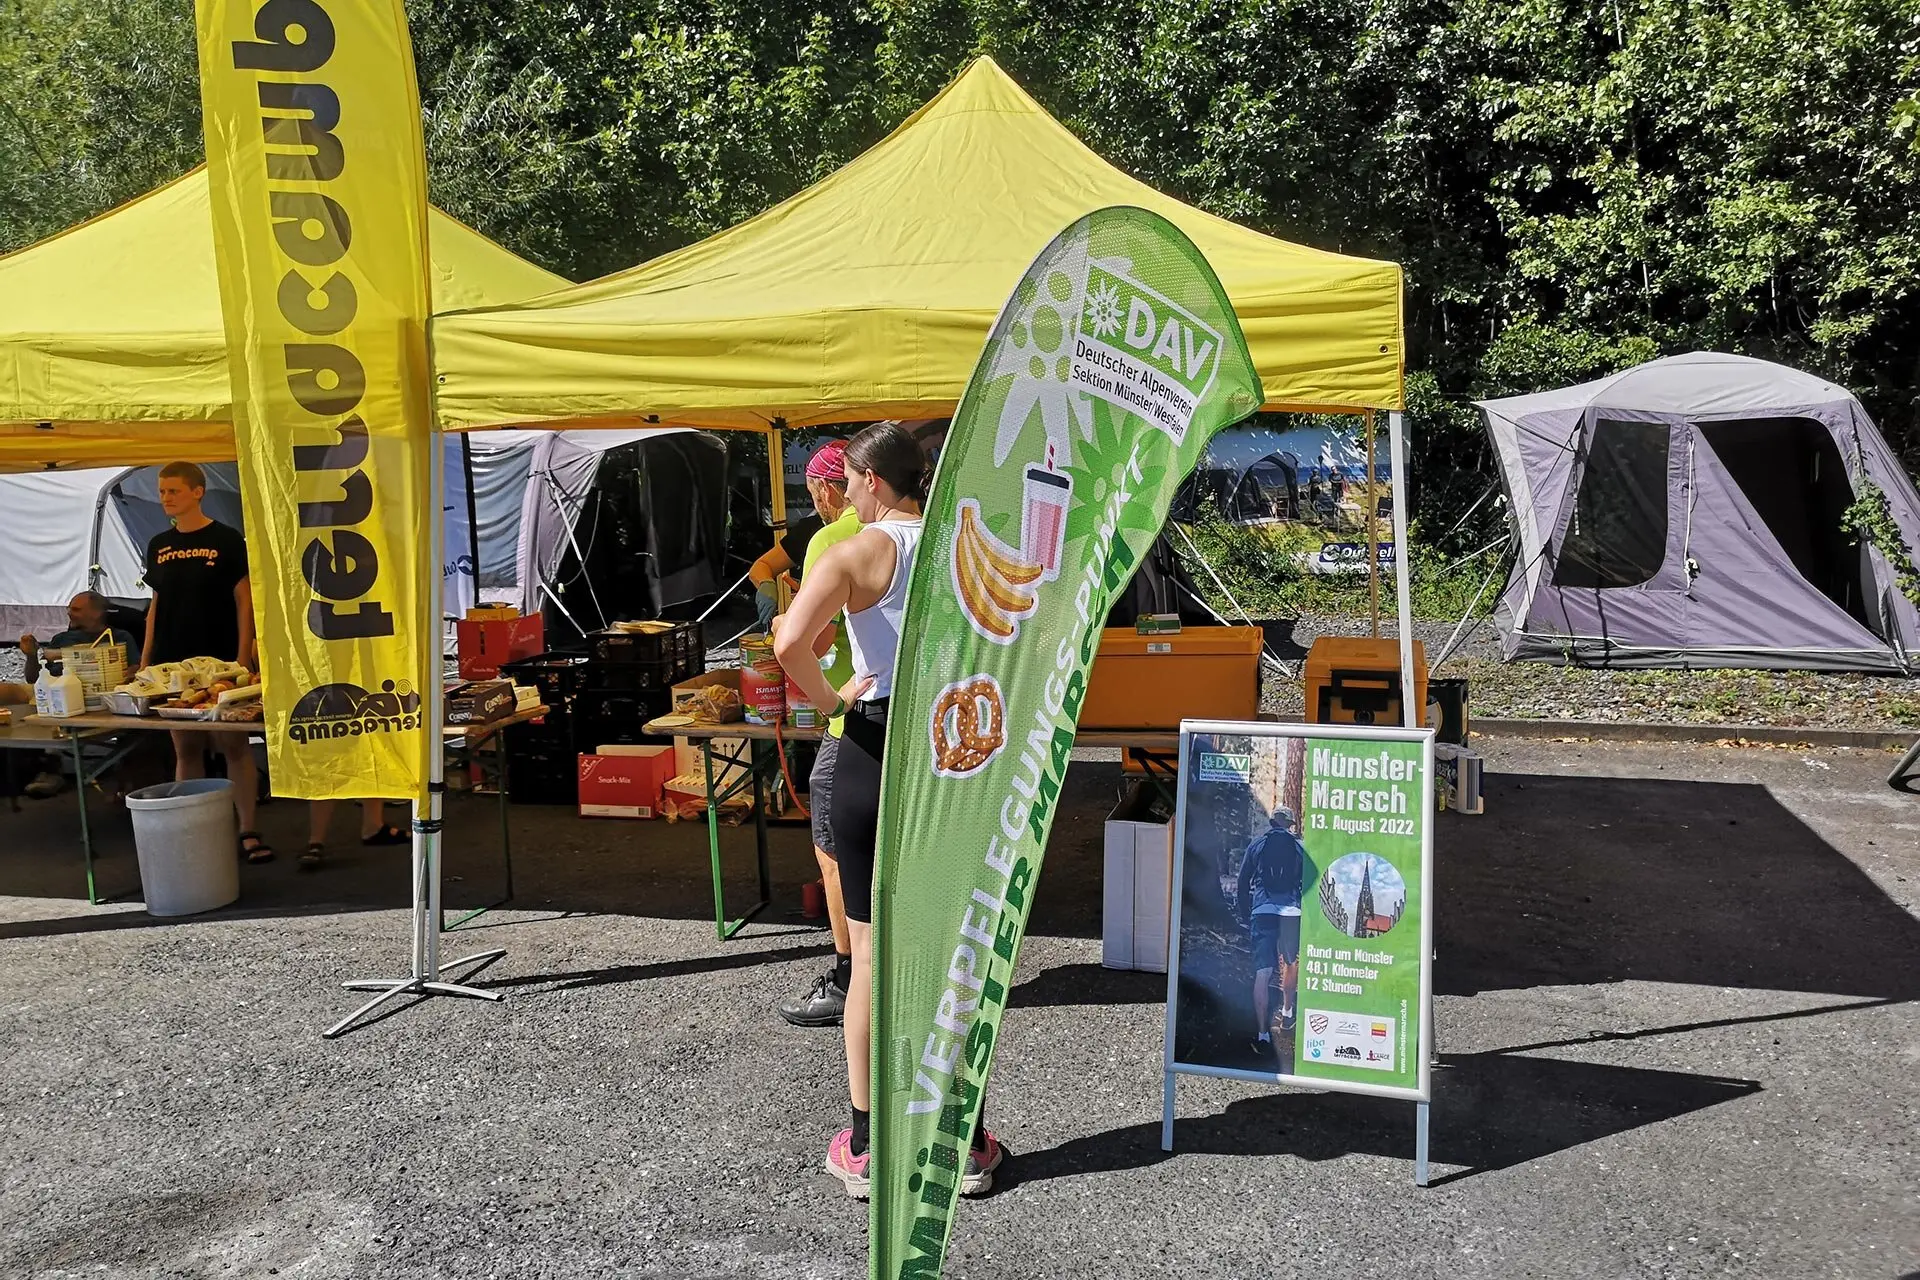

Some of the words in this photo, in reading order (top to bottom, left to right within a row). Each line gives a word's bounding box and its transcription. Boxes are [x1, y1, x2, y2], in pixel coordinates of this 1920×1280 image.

[1124, 295, 1214, 381] DAV
[1076, 340, 1139, 382] Deutscher
[1139, 370, 1193, 419] Alpenverein
[1073, 364, 1112, 393] Sektion
[1114, 381, 1185, 438] Münster/Westfalen
[157, 548, 219, 565] terracamp
[1215, 756, 1248, 770] DAV
[1312, 747, 1424, 782] Münster-
[1311, 780, 1407, 814] Marsch
[1310, 813, 1329, 829] 13.
[1332, 815, 1375, 835] August
[1379, 818, 1415, 835] 2022
[898, 855, 1034, 1280] MÜNSTER
[1027, 526, 1135, 846] MARSCH
[1306, 944, 1332, 959] Rund
[1335, 950, 1352, 961] um
[1306, 960, 1328, 975] 48.1
[1332, 962, 1379, 980] Kilometer
[1306, 977, 1319, 991] 12
[1322, 978, 1362, 995] Stunden
[1399, 998, 1408, 1074] www.münstermarsch.de
